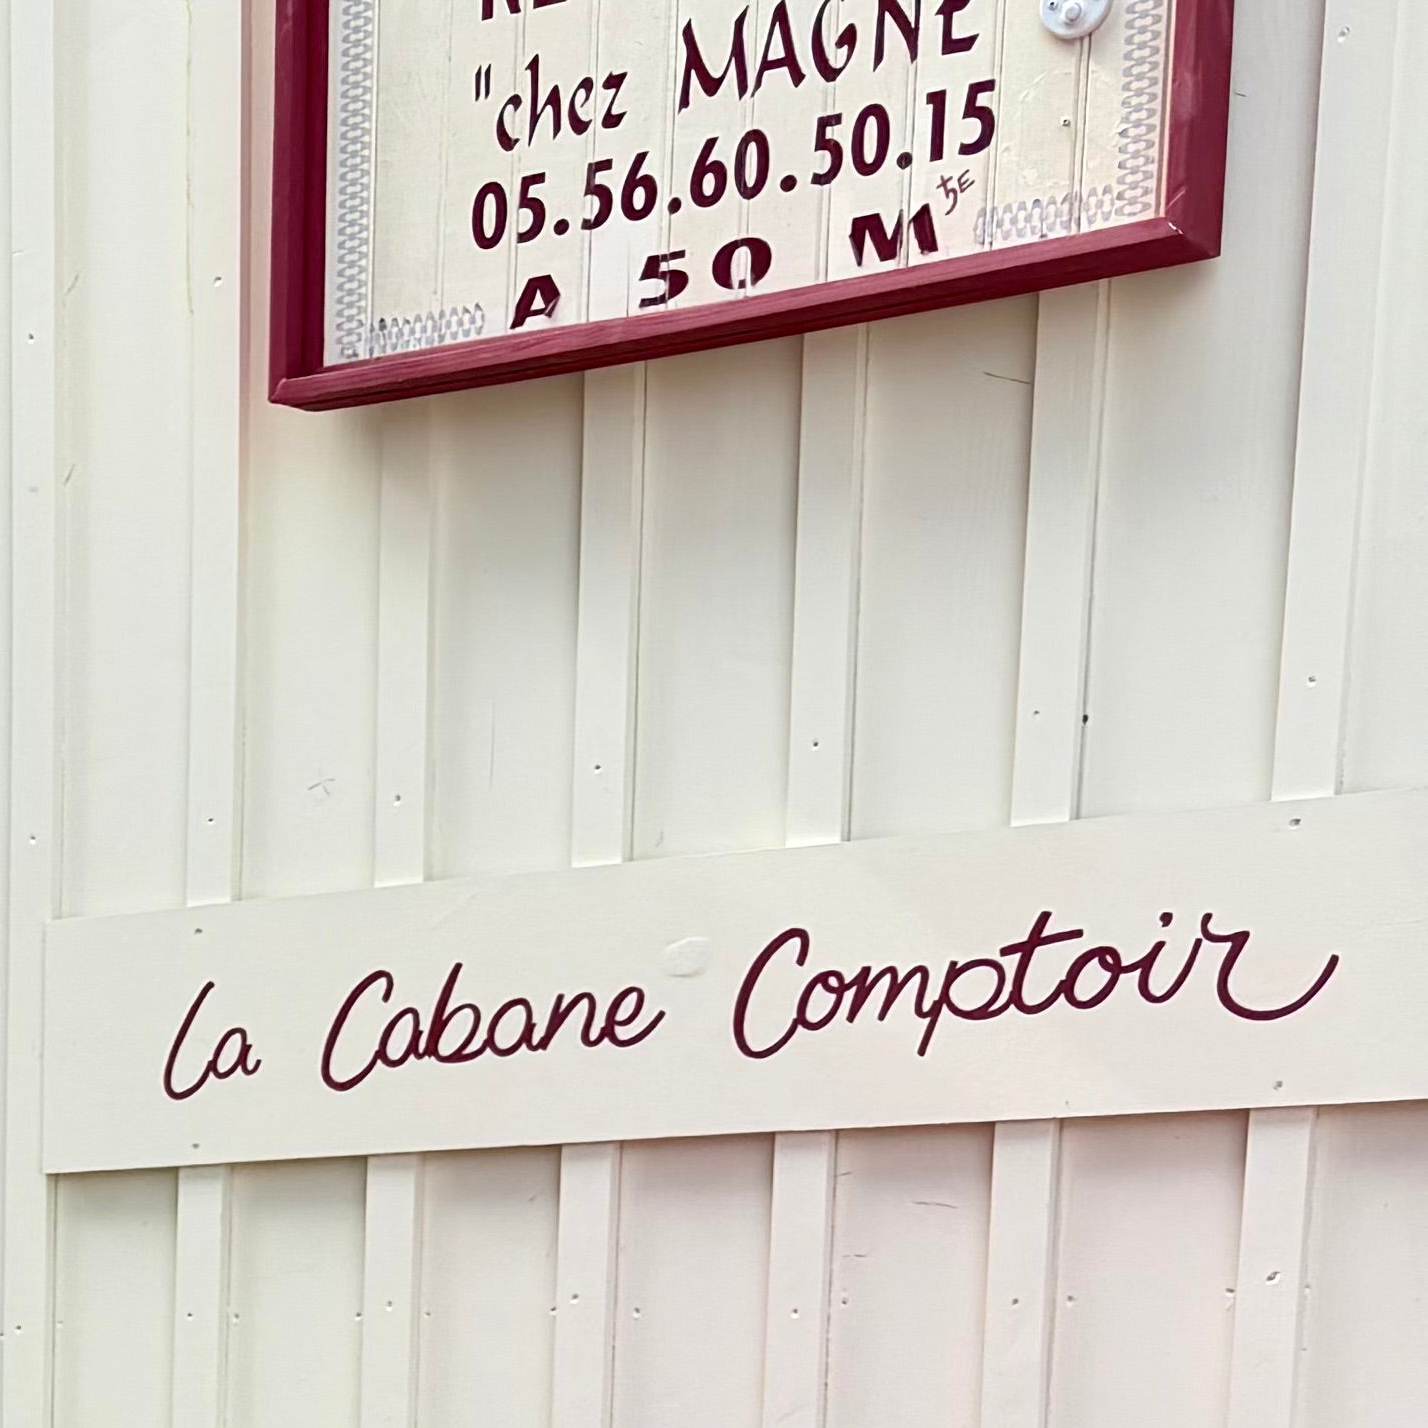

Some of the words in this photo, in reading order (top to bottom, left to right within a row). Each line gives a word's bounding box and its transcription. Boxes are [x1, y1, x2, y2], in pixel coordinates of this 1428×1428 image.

[471, 78, 996, 250] 05.56.60.50.15
[474, 53, 628, 152] "chez
[509, 274, 561, 330] A
[638, 236, 773, 309] 50
[320, 961, 666, 1092] Cabane
[732, 909, 1340, 1060] Comptoir
